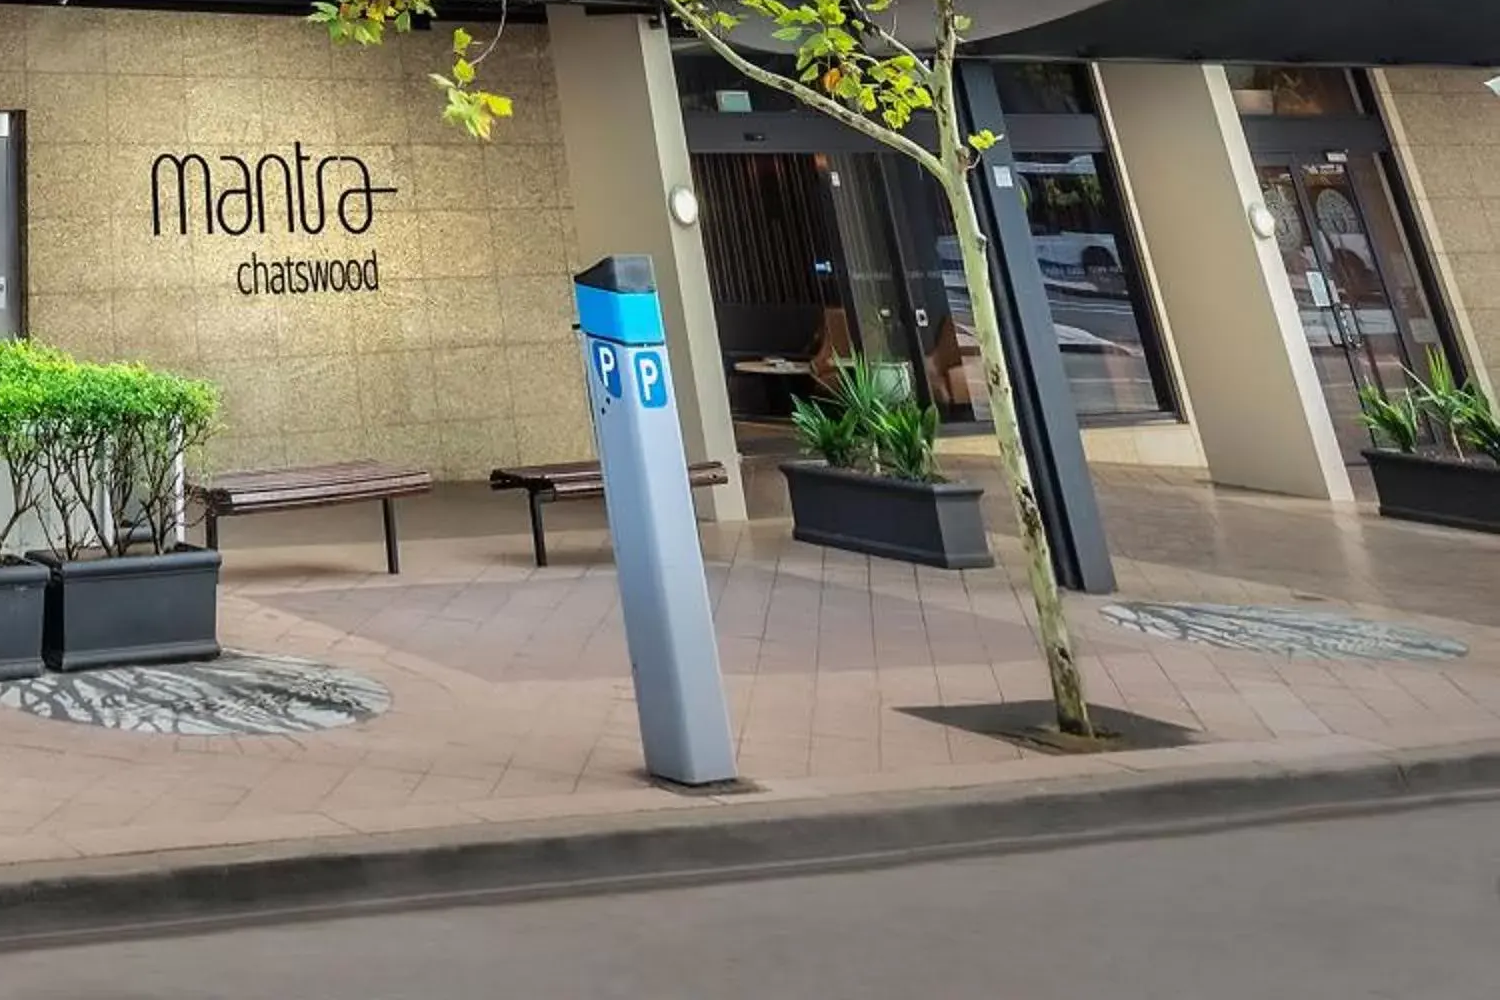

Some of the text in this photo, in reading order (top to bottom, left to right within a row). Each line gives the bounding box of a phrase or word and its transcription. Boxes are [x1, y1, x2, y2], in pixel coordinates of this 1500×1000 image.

[150, 141, 399, 236] mantra
[236, 249, 379, 296] chatswood
[599, 346, 615, 388] P
[639, 358, 659, 401] P
